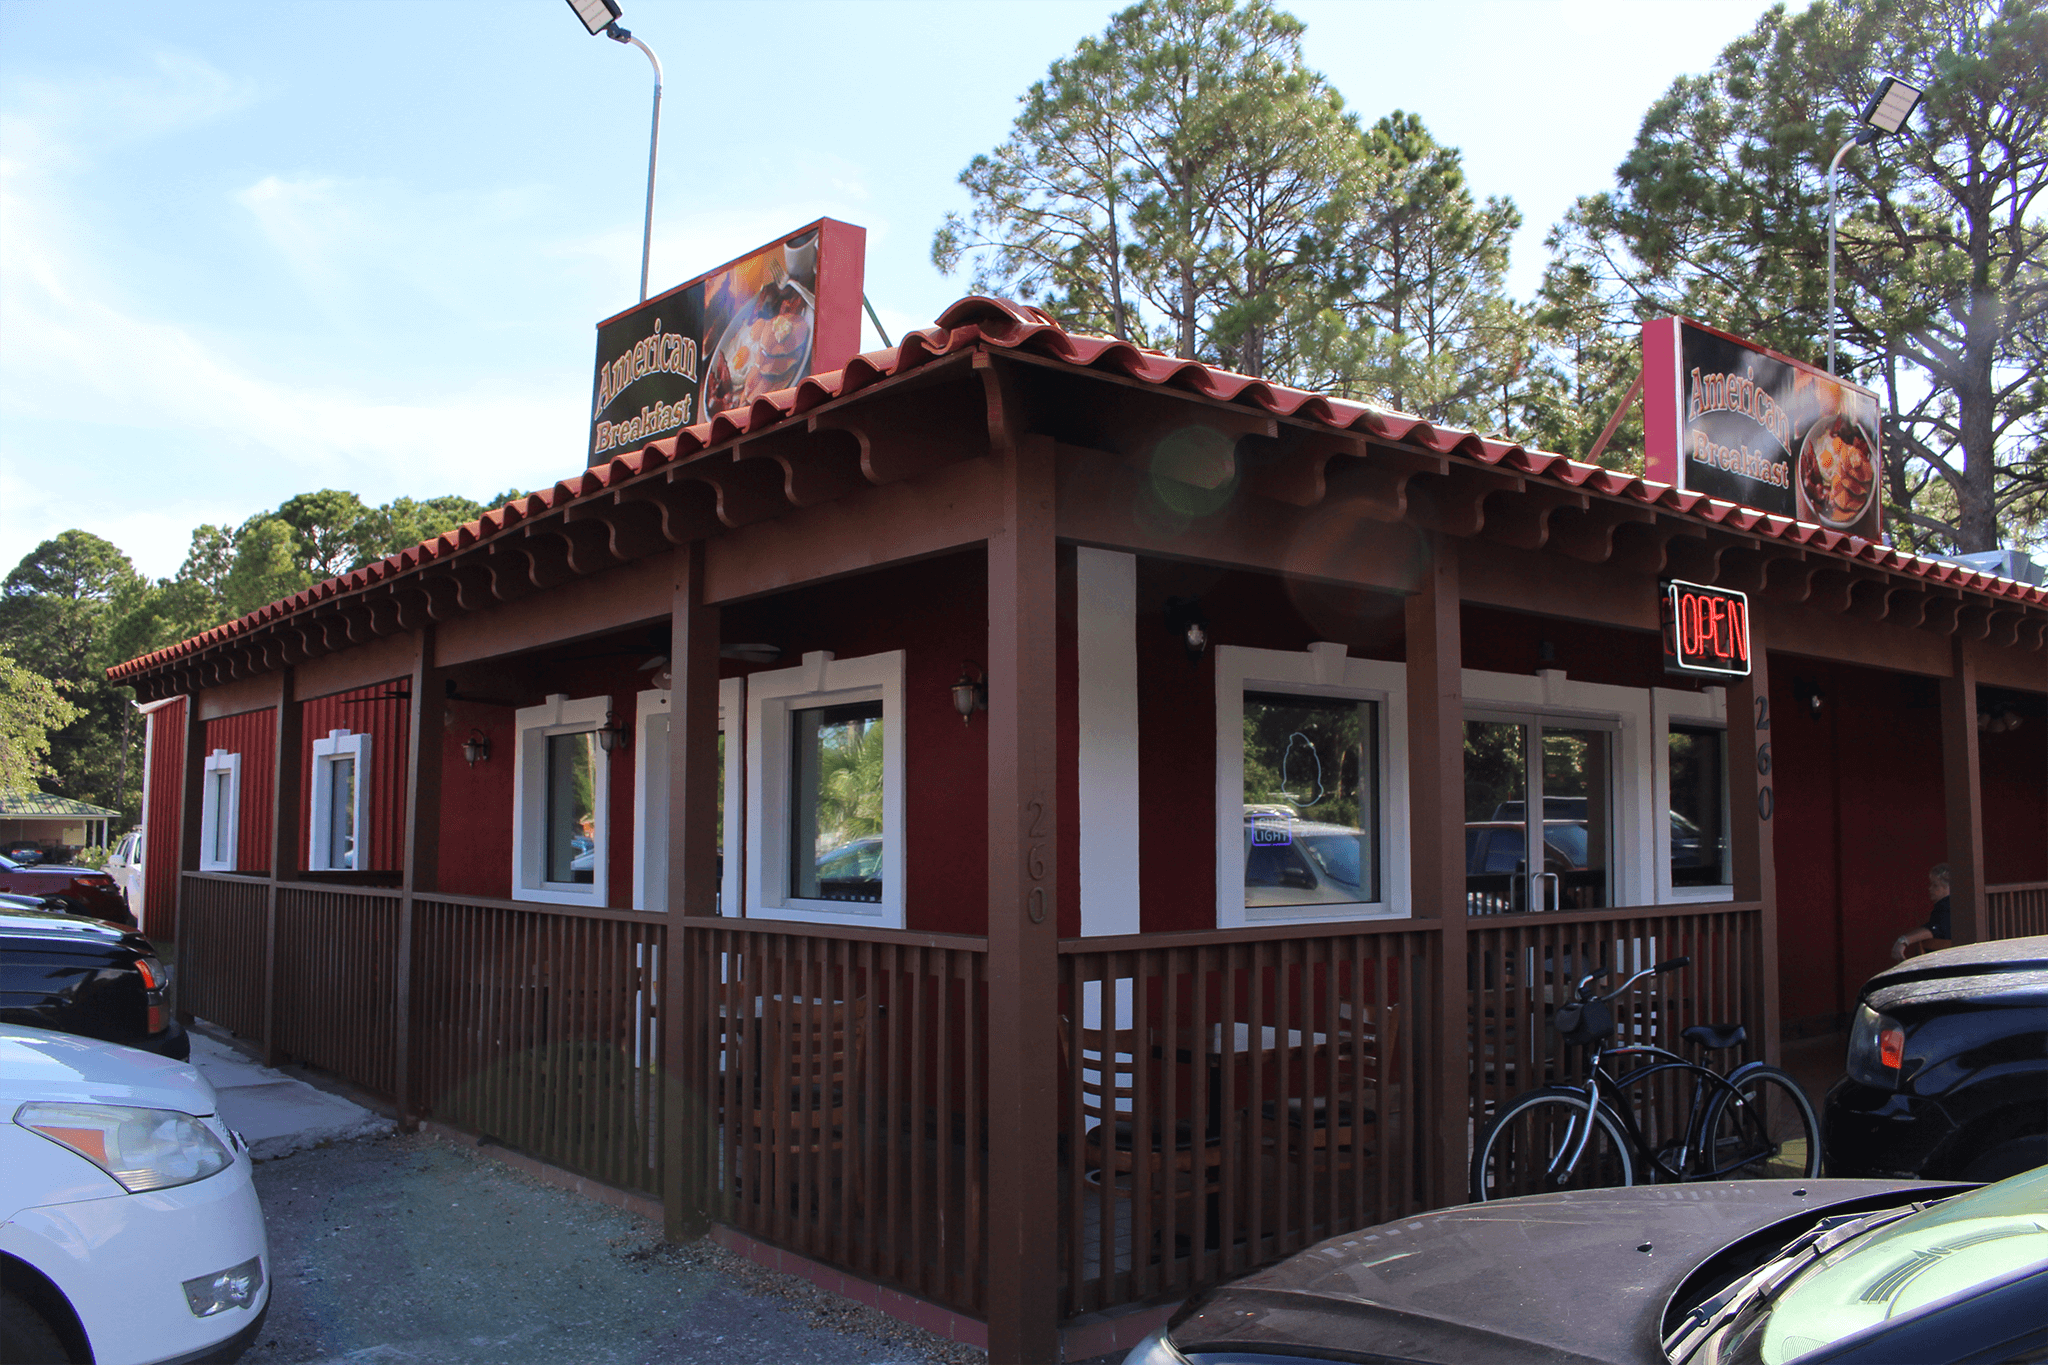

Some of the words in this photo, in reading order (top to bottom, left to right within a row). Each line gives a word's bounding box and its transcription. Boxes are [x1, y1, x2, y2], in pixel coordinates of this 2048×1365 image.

[594, 318, 698, 421] American
[594, 393, 692, 454] Breakfast
[1688, 366, 1792, 457] American
[1692, 428, 1790, 489] Breakfast
[1681, 593, 1747, 661] OPEN
[1755, 695, 1775, 821] 260
[1027, 799, 1048, 925] 260
[1254, 829, 1288, 842] LIGHT
